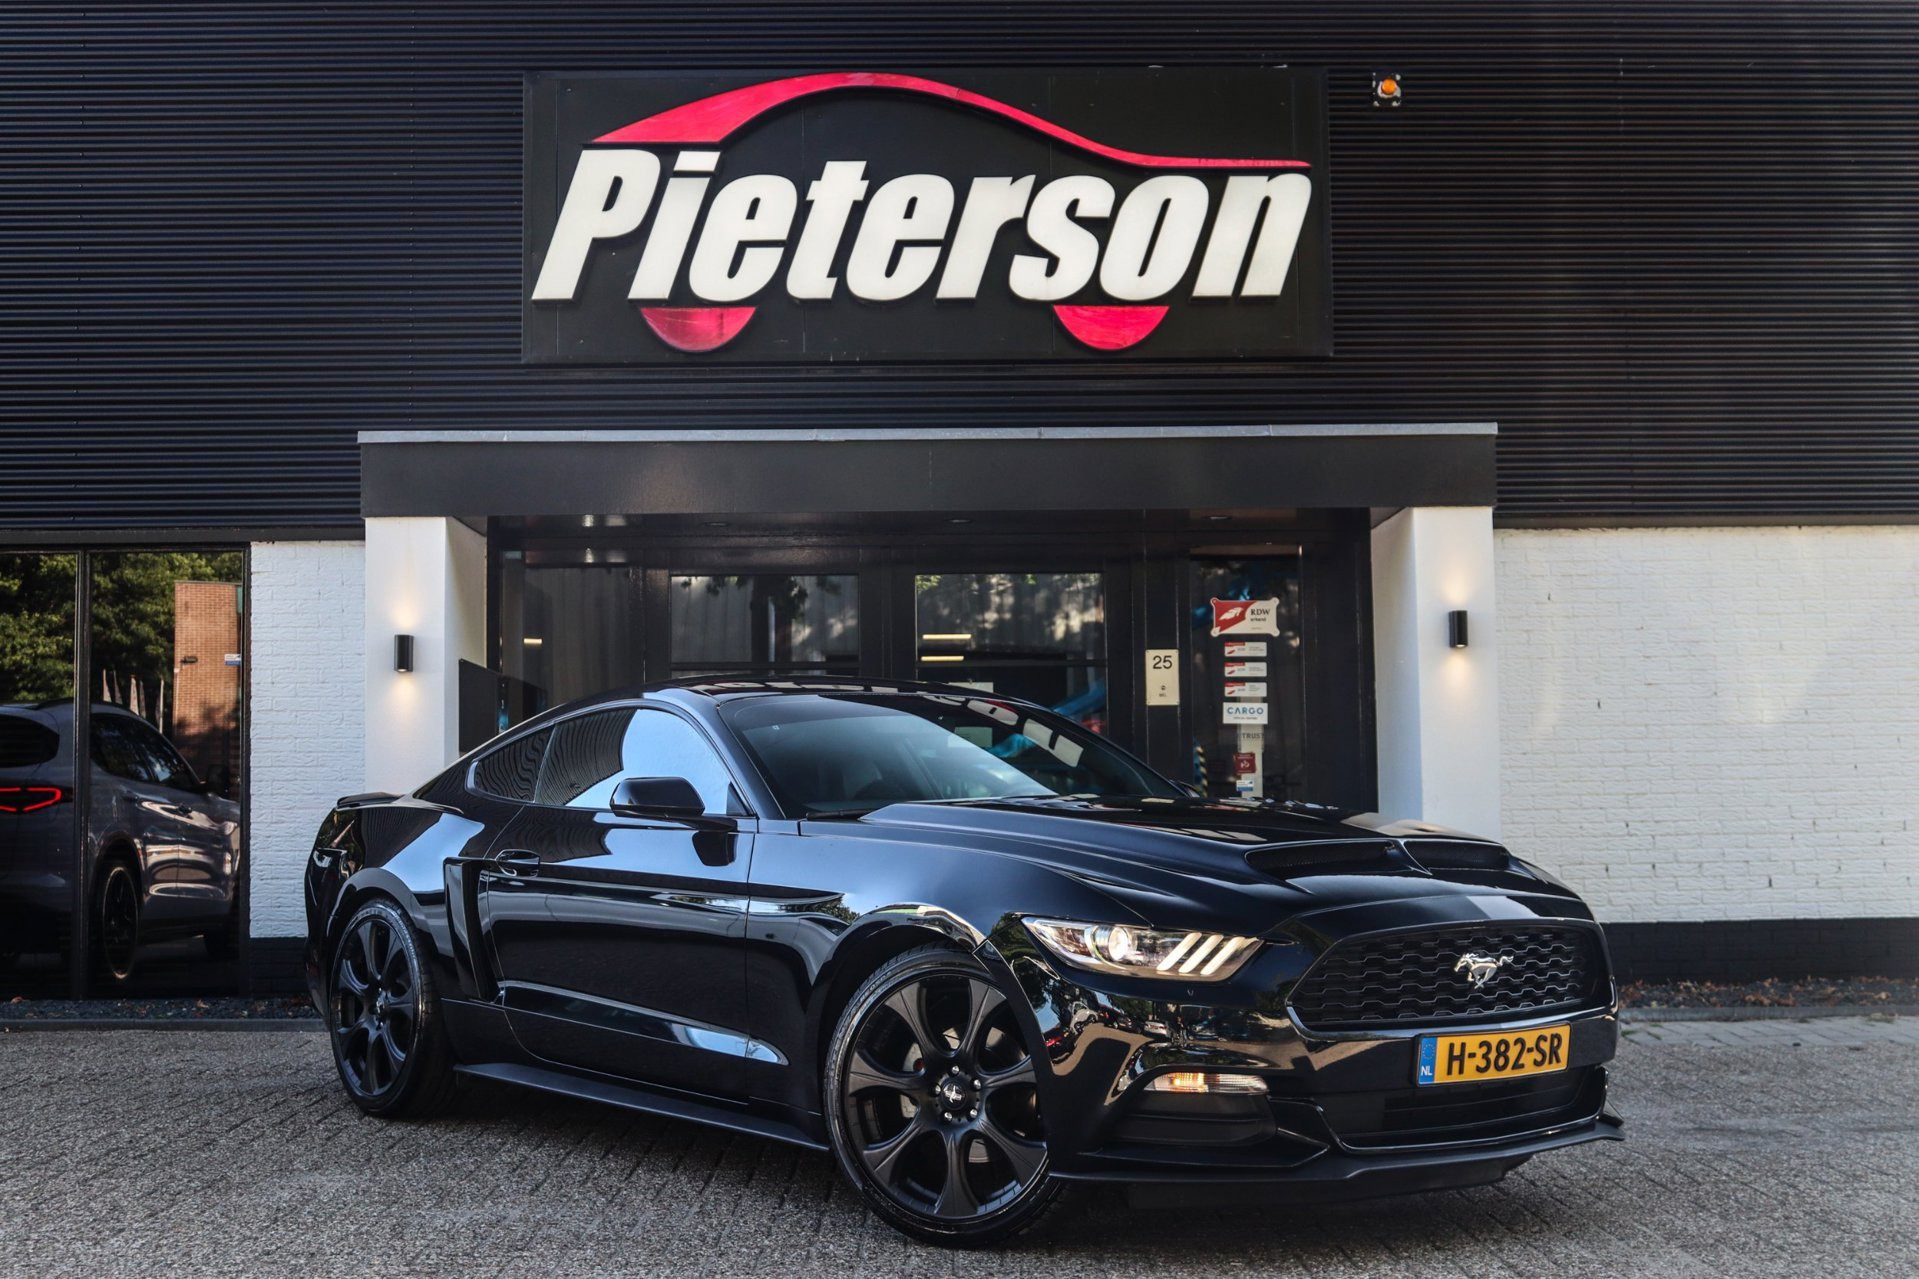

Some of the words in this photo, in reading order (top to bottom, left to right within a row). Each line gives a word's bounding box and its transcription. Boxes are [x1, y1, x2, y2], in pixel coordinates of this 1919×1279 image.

[531, 149, 1312, 302] Pieterson
[1250, 608, 1271, 616] RDW
[1152, 655, 1173, 669] 25
[1226, 706, 1264, 715] CARGO
[1446, 1033, 1563, 1076] H-382-SR
[1420, 1065, 1433, 1076] NL
